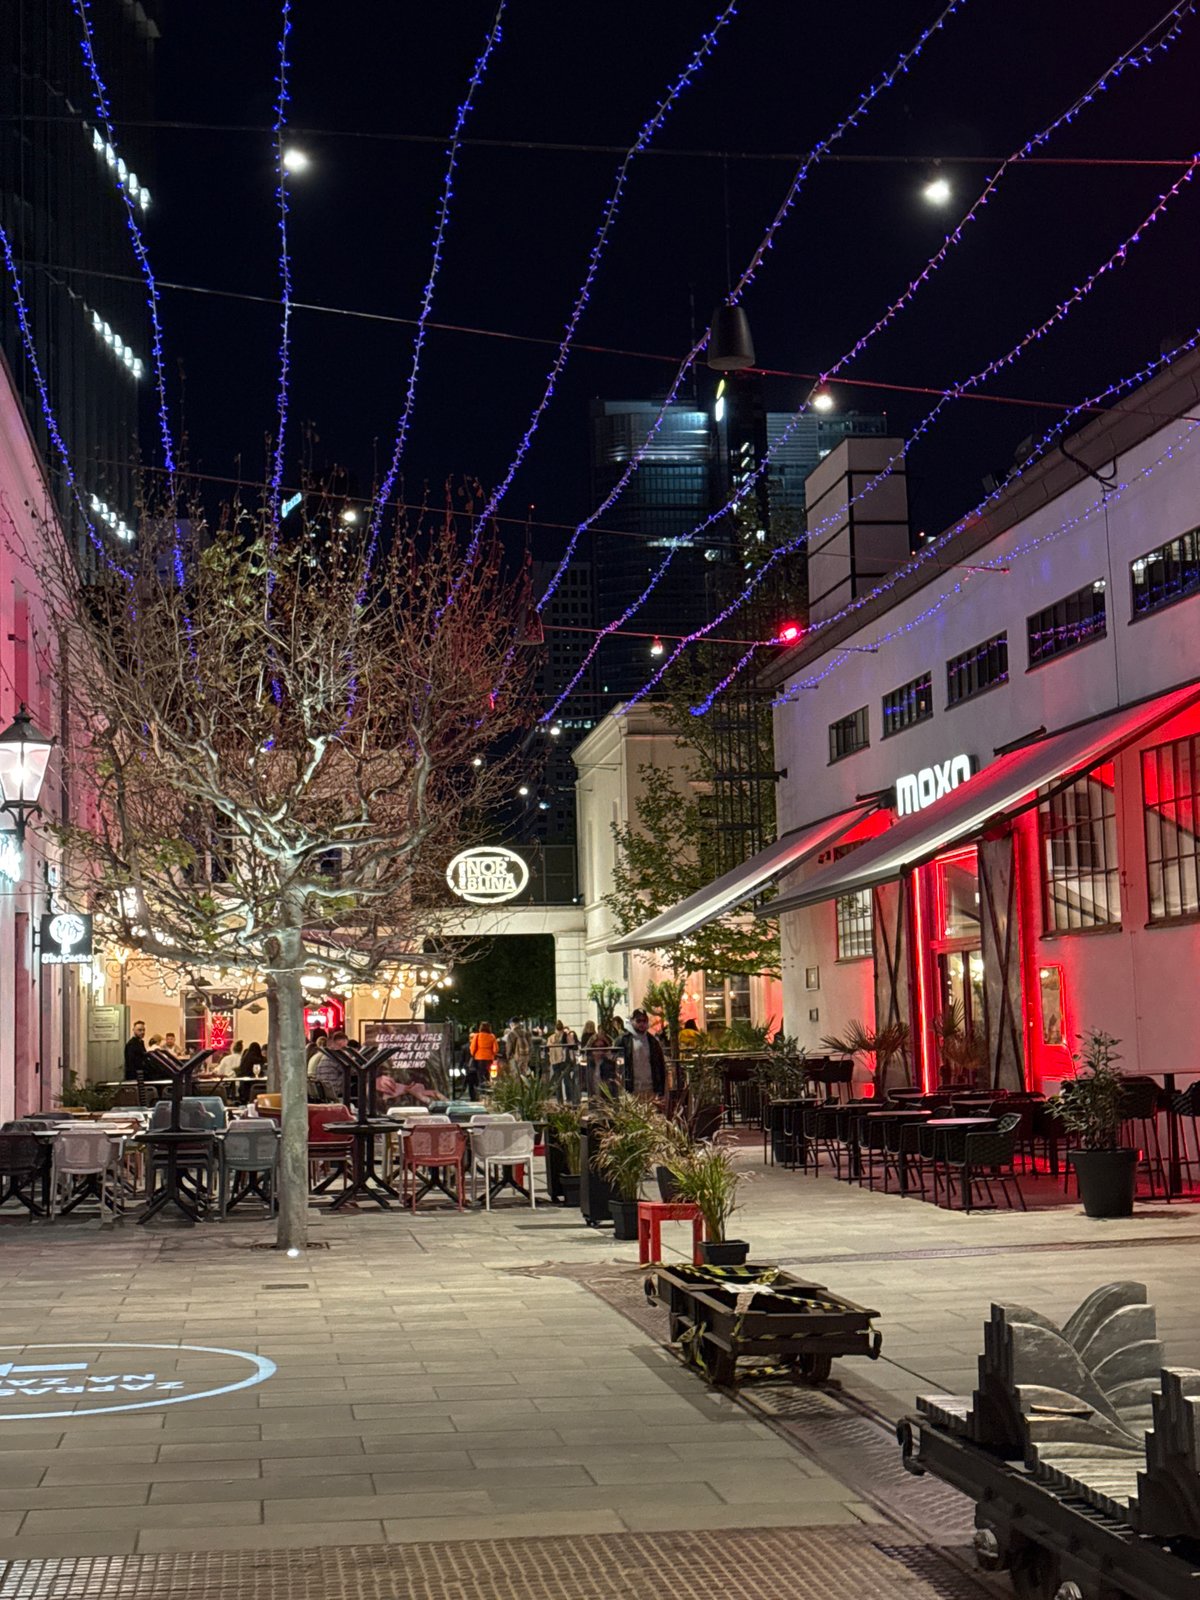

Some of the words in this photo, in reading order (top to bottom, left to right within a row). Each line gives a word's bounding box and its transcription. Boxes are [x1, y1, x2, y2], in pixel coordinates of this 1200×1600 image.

[466, 859, 508, 875] NOR
[467, 874, 518, 891] BLINA
[375, 1033, 419, 1042] LEGENDARY
[421, 1033, 442, 1042] VIBES
[413, 1042, 431, 1051] LIFE
[431, 1042, 440, 1051] IS
[415, 1051, 431, 1060] FOR
[391, 1060, 426, 1069] SHARING
[0, 1377, 69, 1387] ZA
[86, 1373, 156, 1383] NA
